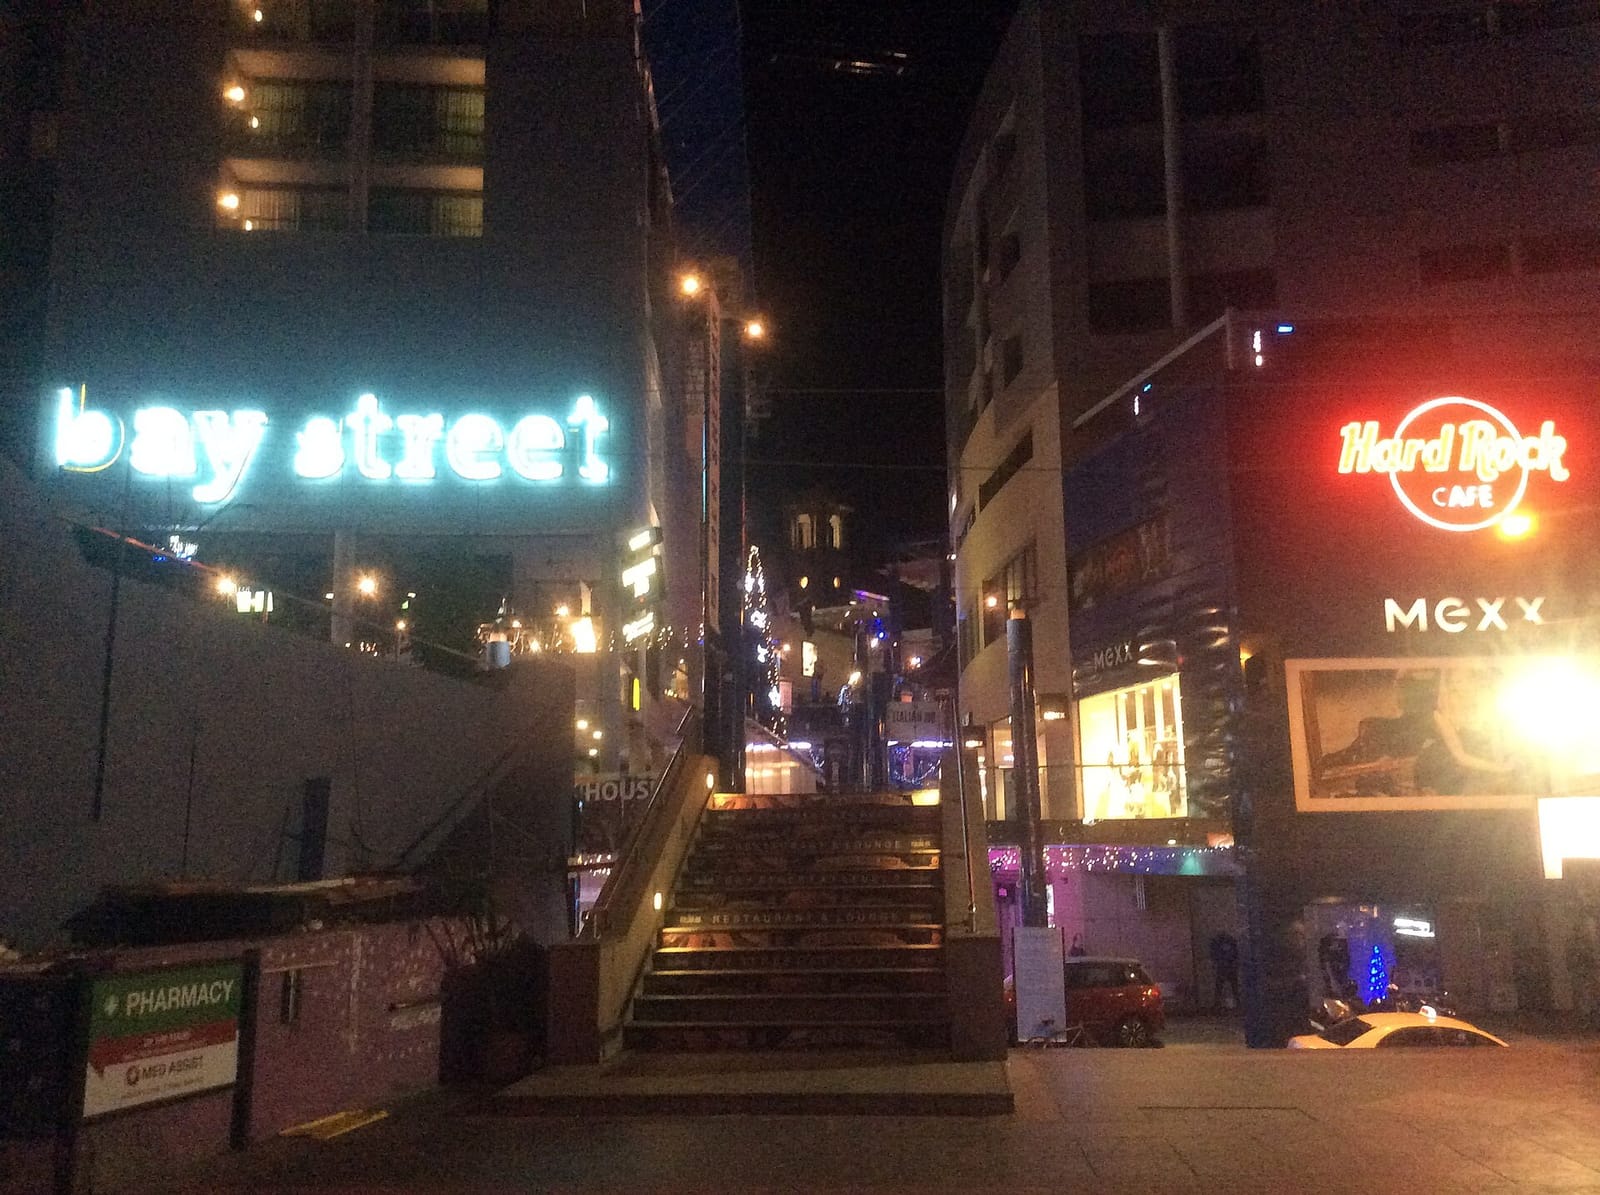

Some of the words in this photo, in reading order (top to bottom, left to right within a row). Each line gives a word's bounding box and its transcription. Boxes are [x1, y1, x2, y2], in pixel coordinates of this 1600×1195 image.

[56, 383, 269, 504] bay
[294, 393, 608, 482] street
[1338, 420, 1455, 474] Hard
[1459, 420, 1570, 482] Rock
[1432, 484, 1494, 508] CAFE
[126, 979, 234, 1016] PHARMACY
